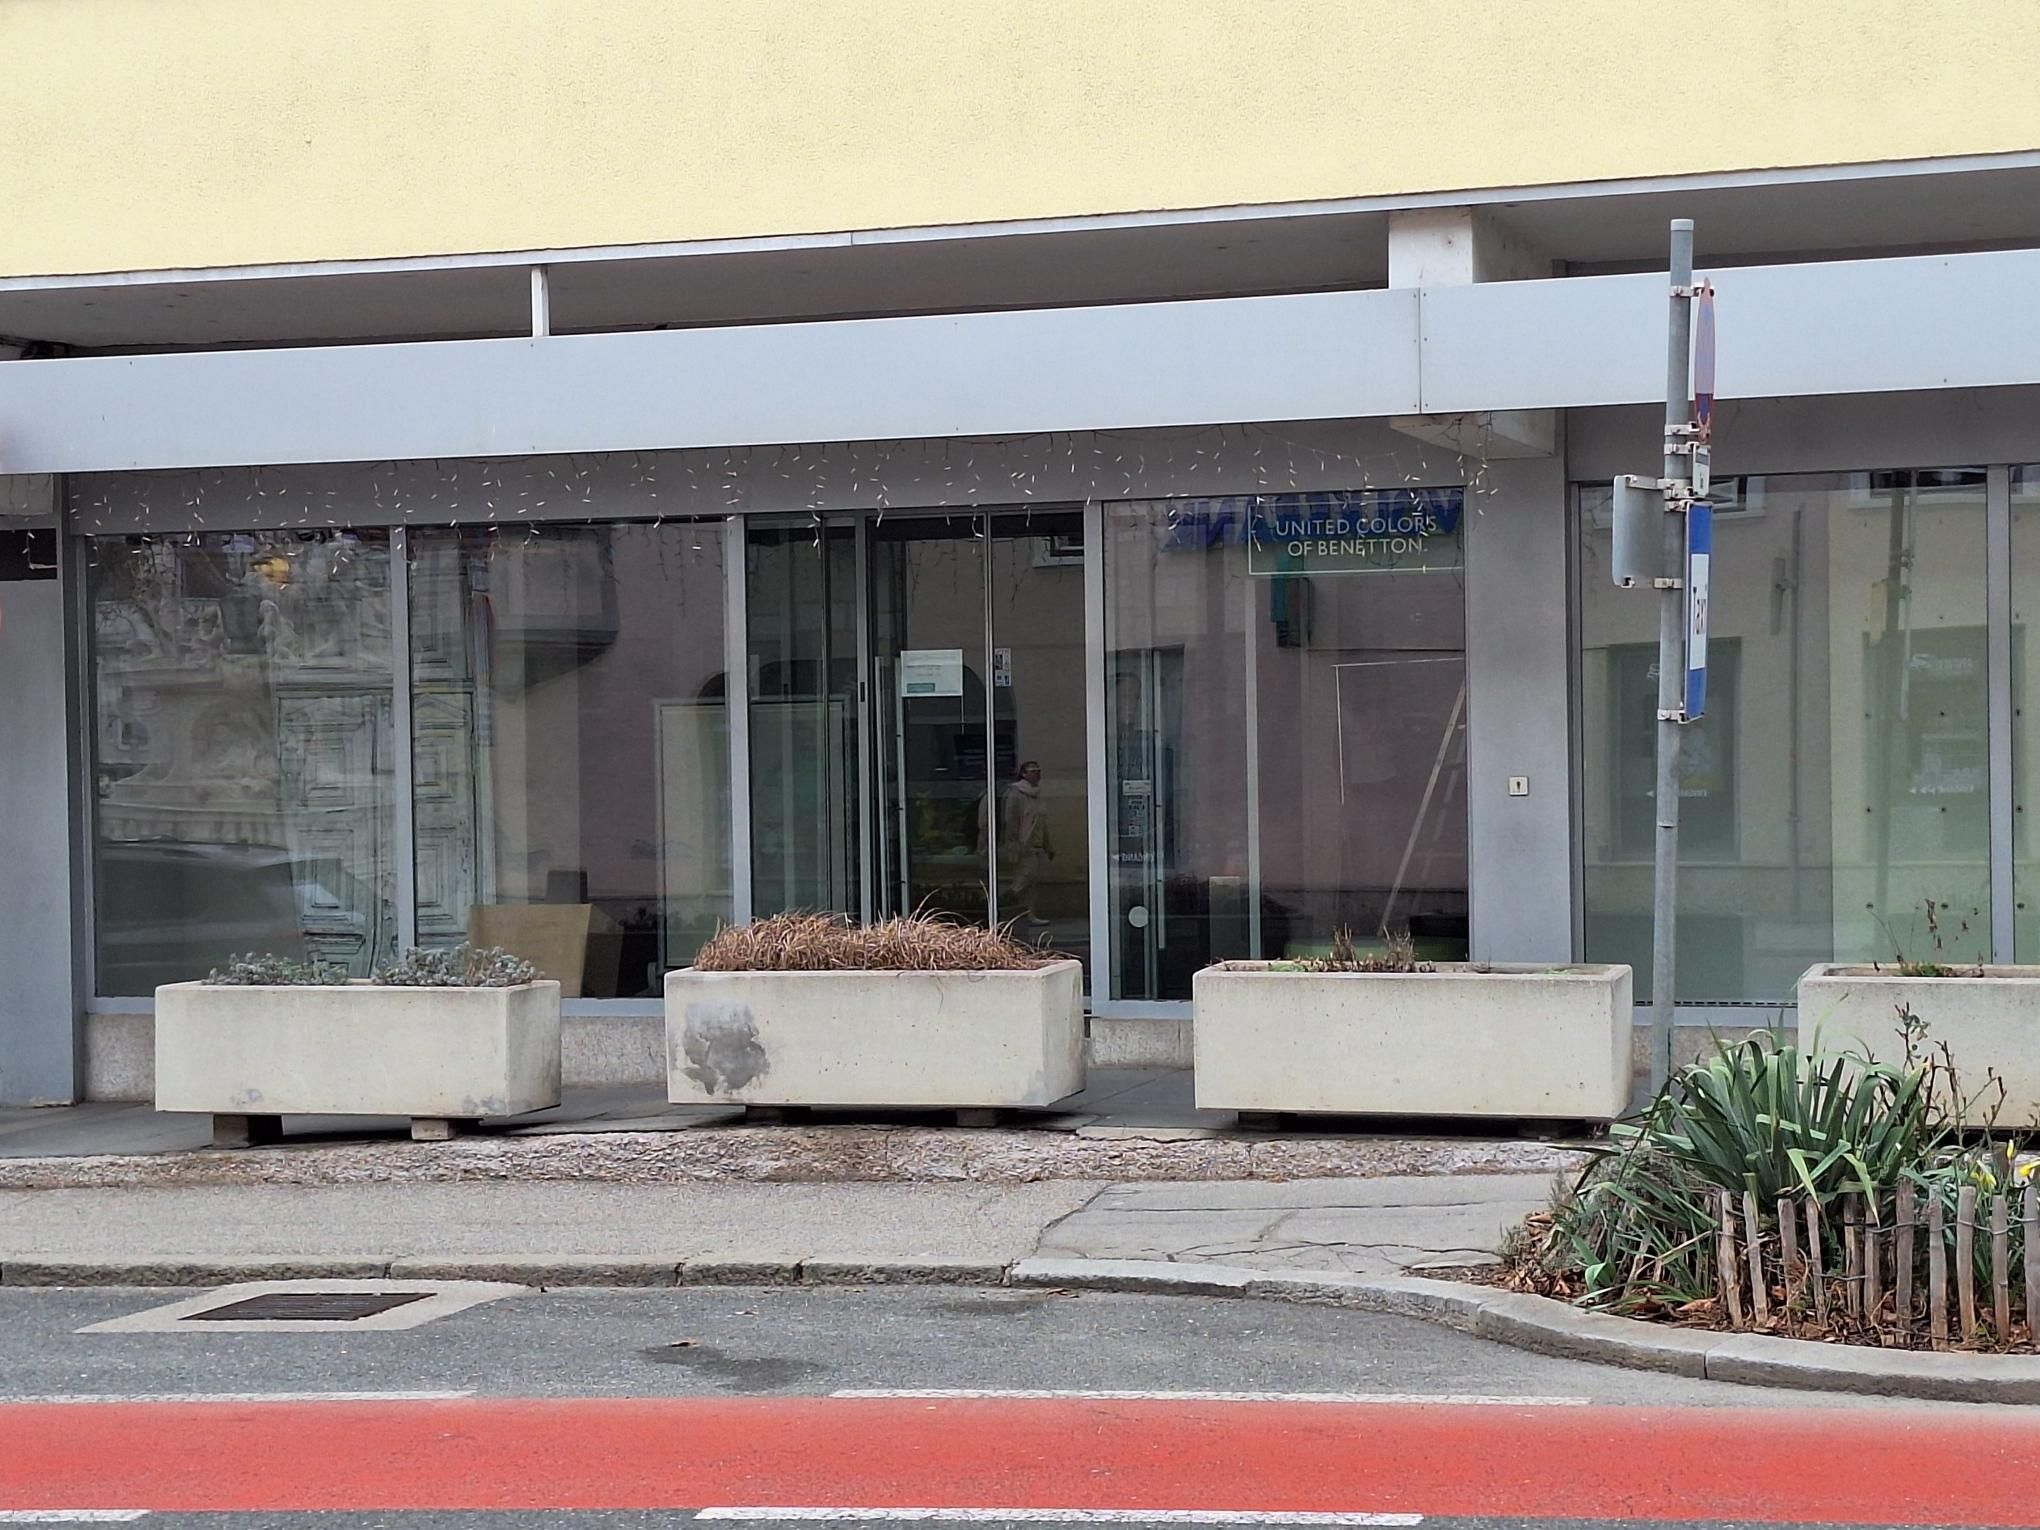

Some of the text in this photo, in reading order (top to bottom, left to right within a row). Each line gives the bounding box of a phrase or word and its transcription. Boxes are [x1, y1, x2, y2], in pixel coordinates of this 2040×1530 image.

[1276, 516, 1437, 536] UNITED COLORS
[1287, 540, 1312, 557] OF
